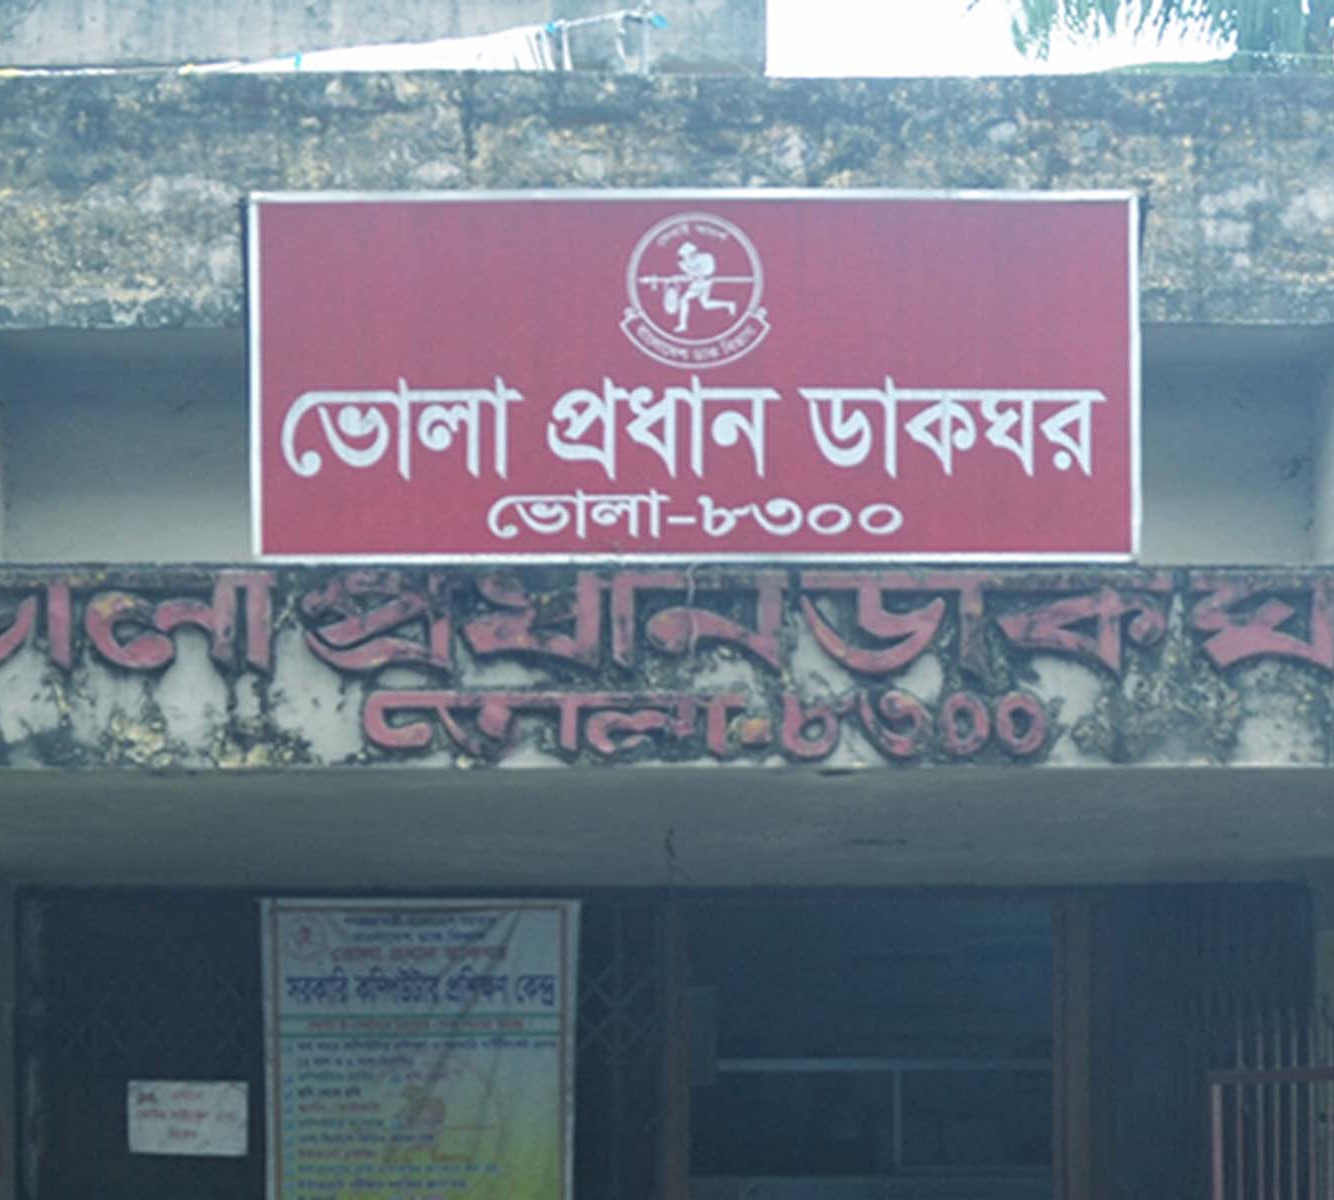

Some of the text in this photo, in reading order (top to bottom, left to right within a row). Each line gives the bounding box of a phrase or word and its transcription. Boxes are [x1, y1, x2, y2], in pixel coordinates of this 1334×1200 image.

[282, 375, 1107, 480] ভোলা প্রধান ডাকঘর
[487, 488, 903, 539] ভোলা-৮৩০০
[299, 570, 785, 673] প্রধান
